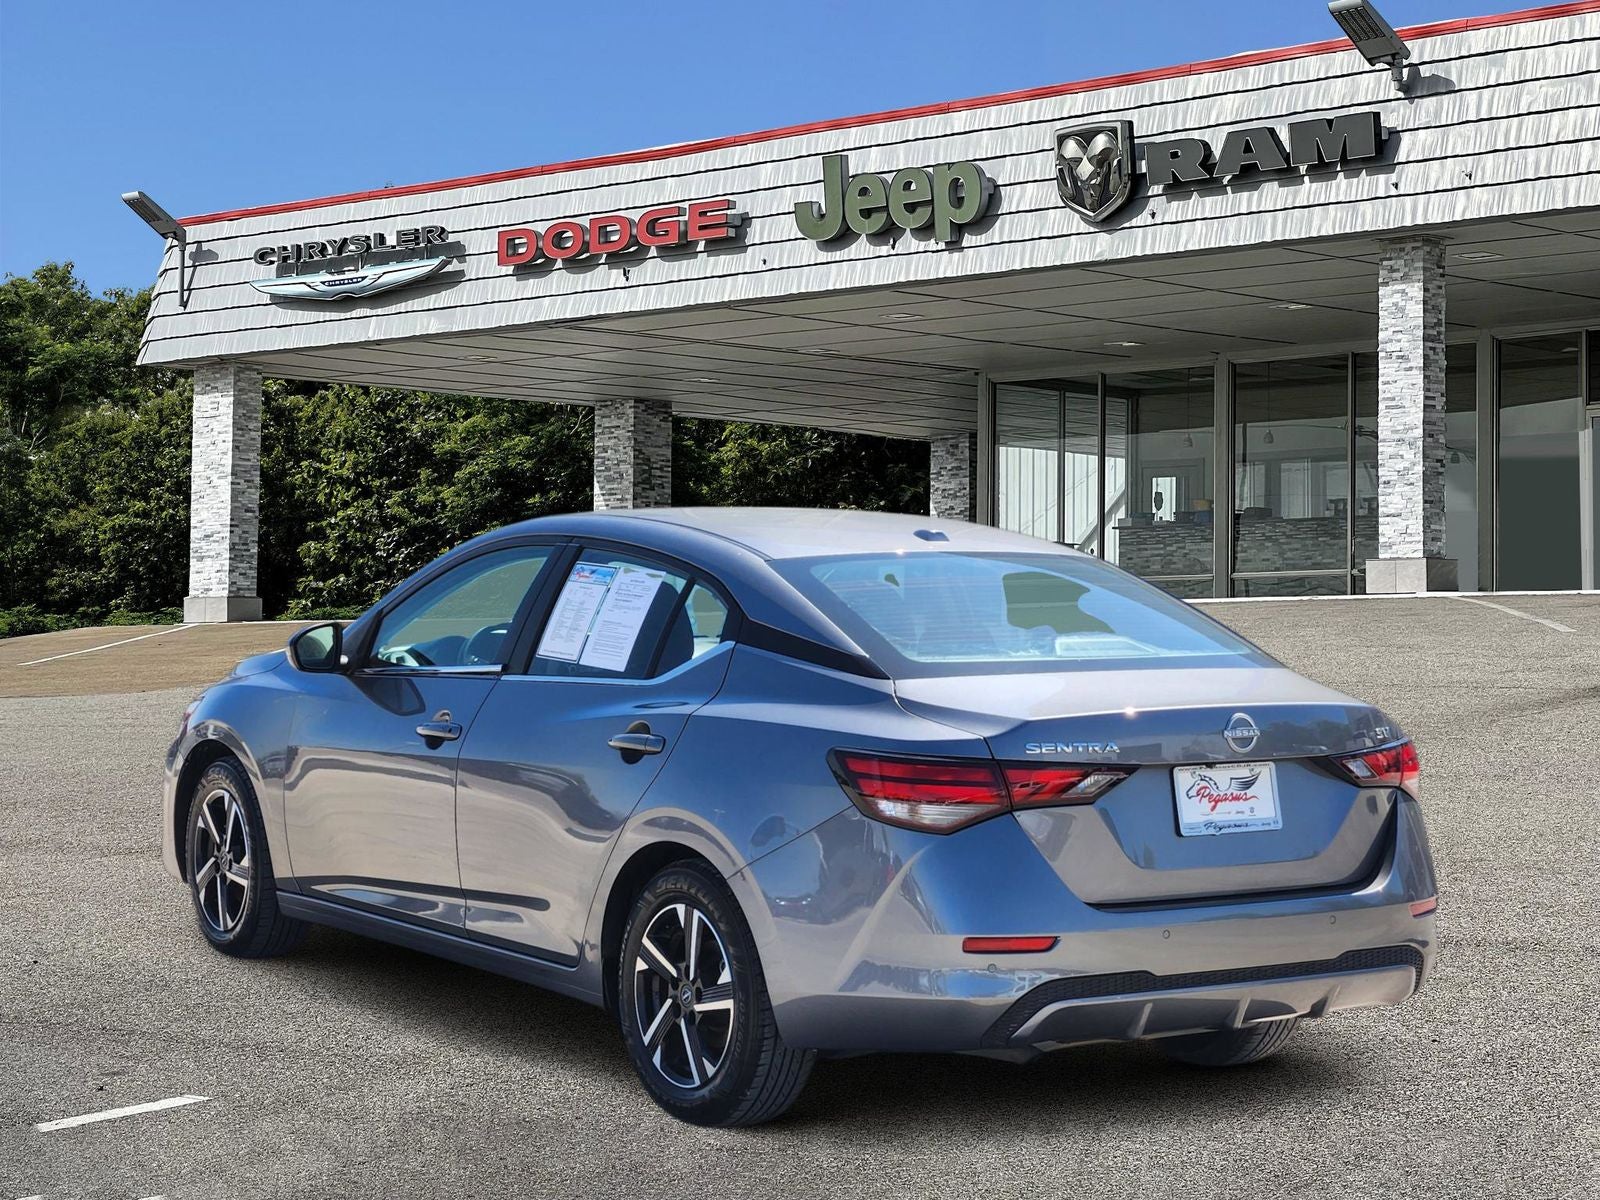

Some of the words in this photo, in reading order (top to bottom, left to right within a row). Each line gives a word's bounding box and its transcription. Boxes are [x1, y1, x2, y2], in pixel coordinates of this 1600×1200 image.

[1145, 111, 1381, 187] RAM
[794, 154, 988, 242] Jeep
[253, 225, 448, 266] CHRYSLER
[497, 199, 737, 266] DODGE
[1025, 742, 1120, 754] SENTRA
[1223, 728, 1260, 738] NISSAN
[1196, 785, 1260, 812] Pegasus
